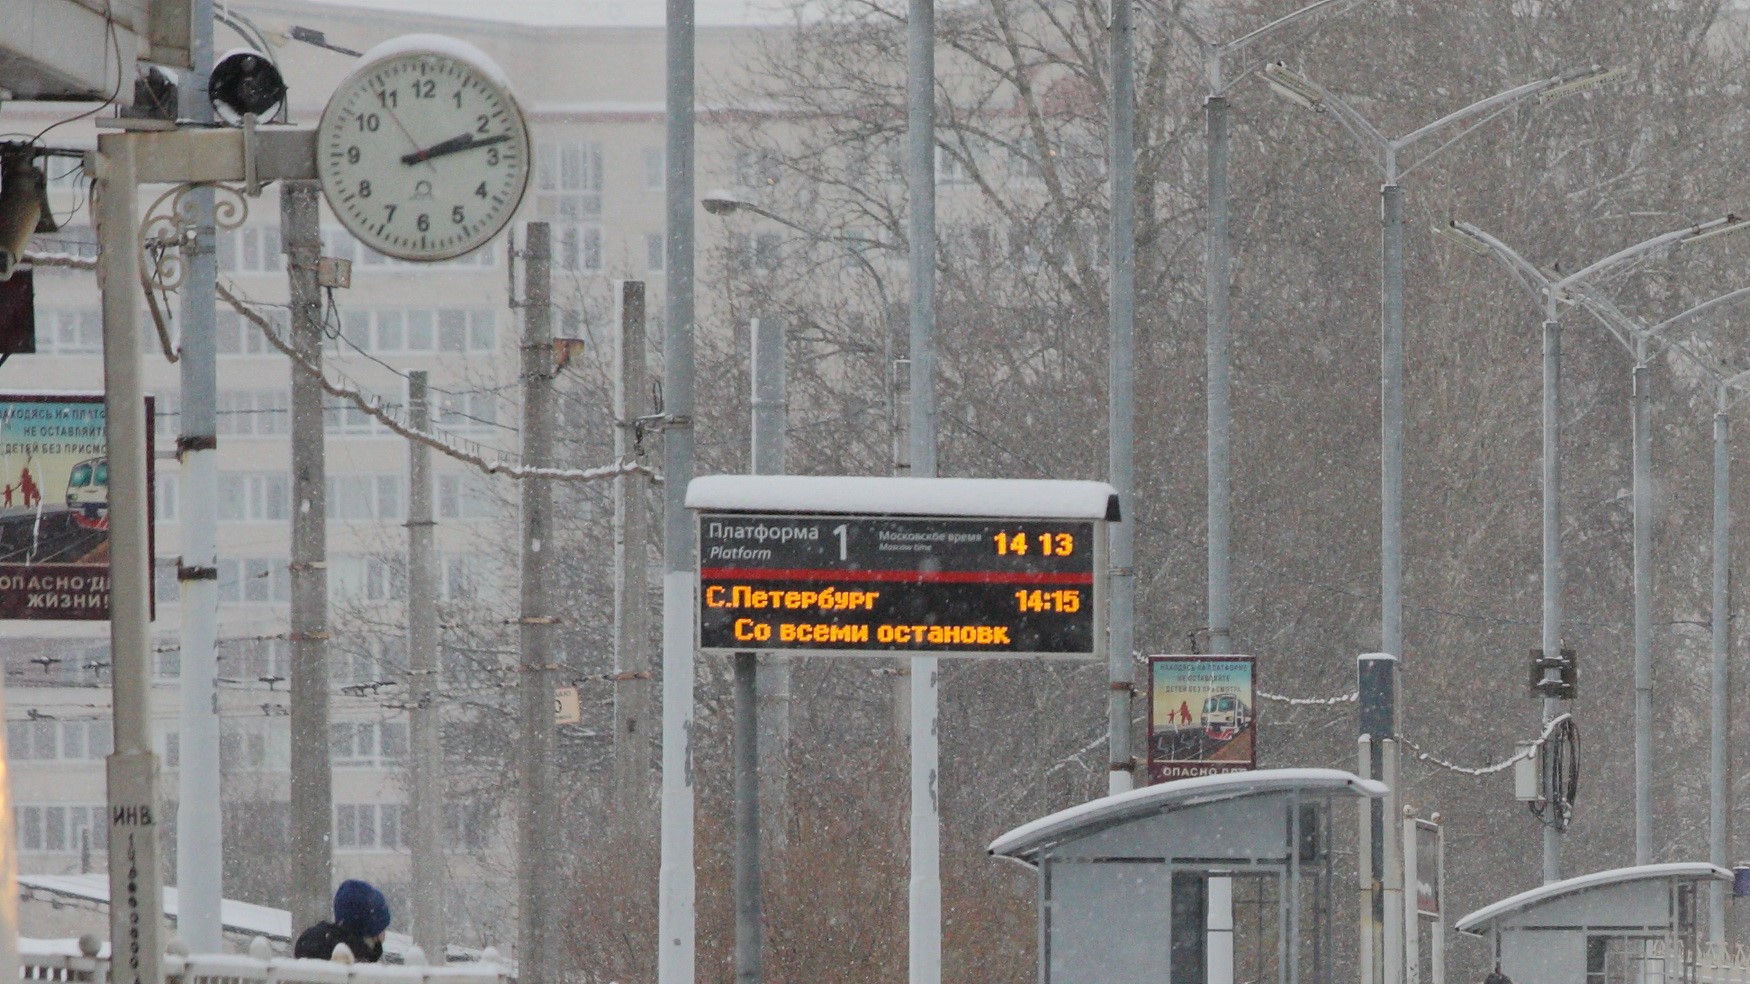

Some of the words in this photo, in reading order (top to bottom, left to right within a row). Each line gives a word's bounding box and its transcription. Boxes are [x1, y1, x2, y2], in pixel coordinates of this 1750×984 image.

[378, 89, 398, 108] 11
[412, 79, 436, 99] 12
[452, 90, 462, 109] 1
[355, 113, 380, 132] 10
[477, 114, 490, 133] 2
[347, 145, 360, 164] 9
[486, 147, 499, 166] 3
[358, 179, 371, 198] 8
[474, 181, 487, 199] 4
[384, 204, 397, 223] 7
[417, 213, 430, 232] 6
[452, 205, 464, 224] 5
[23, 426, 37, 437] НЕ
[42, 443, 61, 454] БЕЗ
[709, 522, 819, 544] Платформа
[832, 524, 848, 561] 1
[993, 531, 1028, 556] 14
[1038, 532, 1074, 557] 13
[710, 545, 772, 561] Platform
[0, 576, 84, 590] ОПАСНО
[27, 591, 109, 609] ЖИЗНИ!
[706, 585, 880, 611] С.Петербург
[1014, 589, 1080, 613] 14:15
[734, 618, 772, 641] Со
[780, 623, 869, 643] всеми
[877, 624, 1011, 645] остановк
[1163, 767, 1217, 776] ОПАСНО
